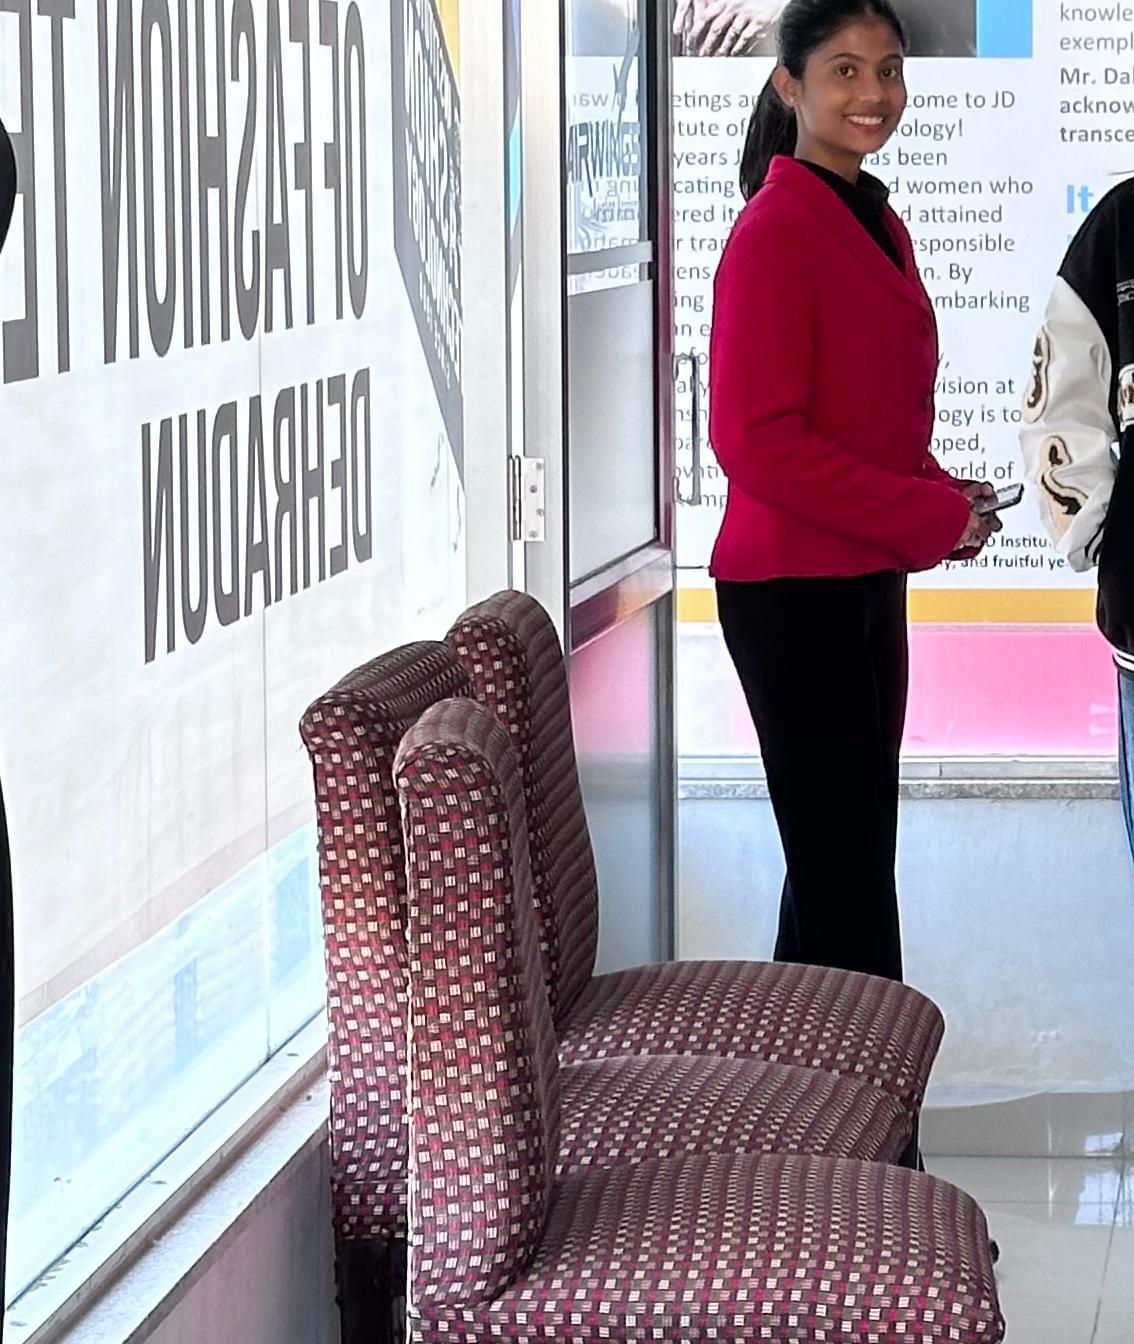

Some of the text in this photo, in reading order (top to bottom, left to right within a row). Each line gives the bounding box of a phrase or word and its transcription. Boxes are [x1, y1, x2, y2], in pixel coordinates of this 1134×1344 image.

[1060, 66, 1096, 85] Mr.
[966, 92, 986, 109] to
[991, 91, 1015, 109] JD
[898, 147, 947, 166] been
[672, 176, 735, 198] cating
[906, 181, 982, 194] women
[989, 176, 1033, 194] who
[1067, 184, 1094, 214] It
[919, 205, 1002, 223] attained
[949, 263, 973, 285] By
[935, 290, 1030, 313] mbarking
[996, 379, 1015, 394] at
[981, 404, 996, 423] is
[1003, 407, 1022, 423] to
[994, 461, 1015, 479] of
[993, 555, 1043, 568] fruitful
